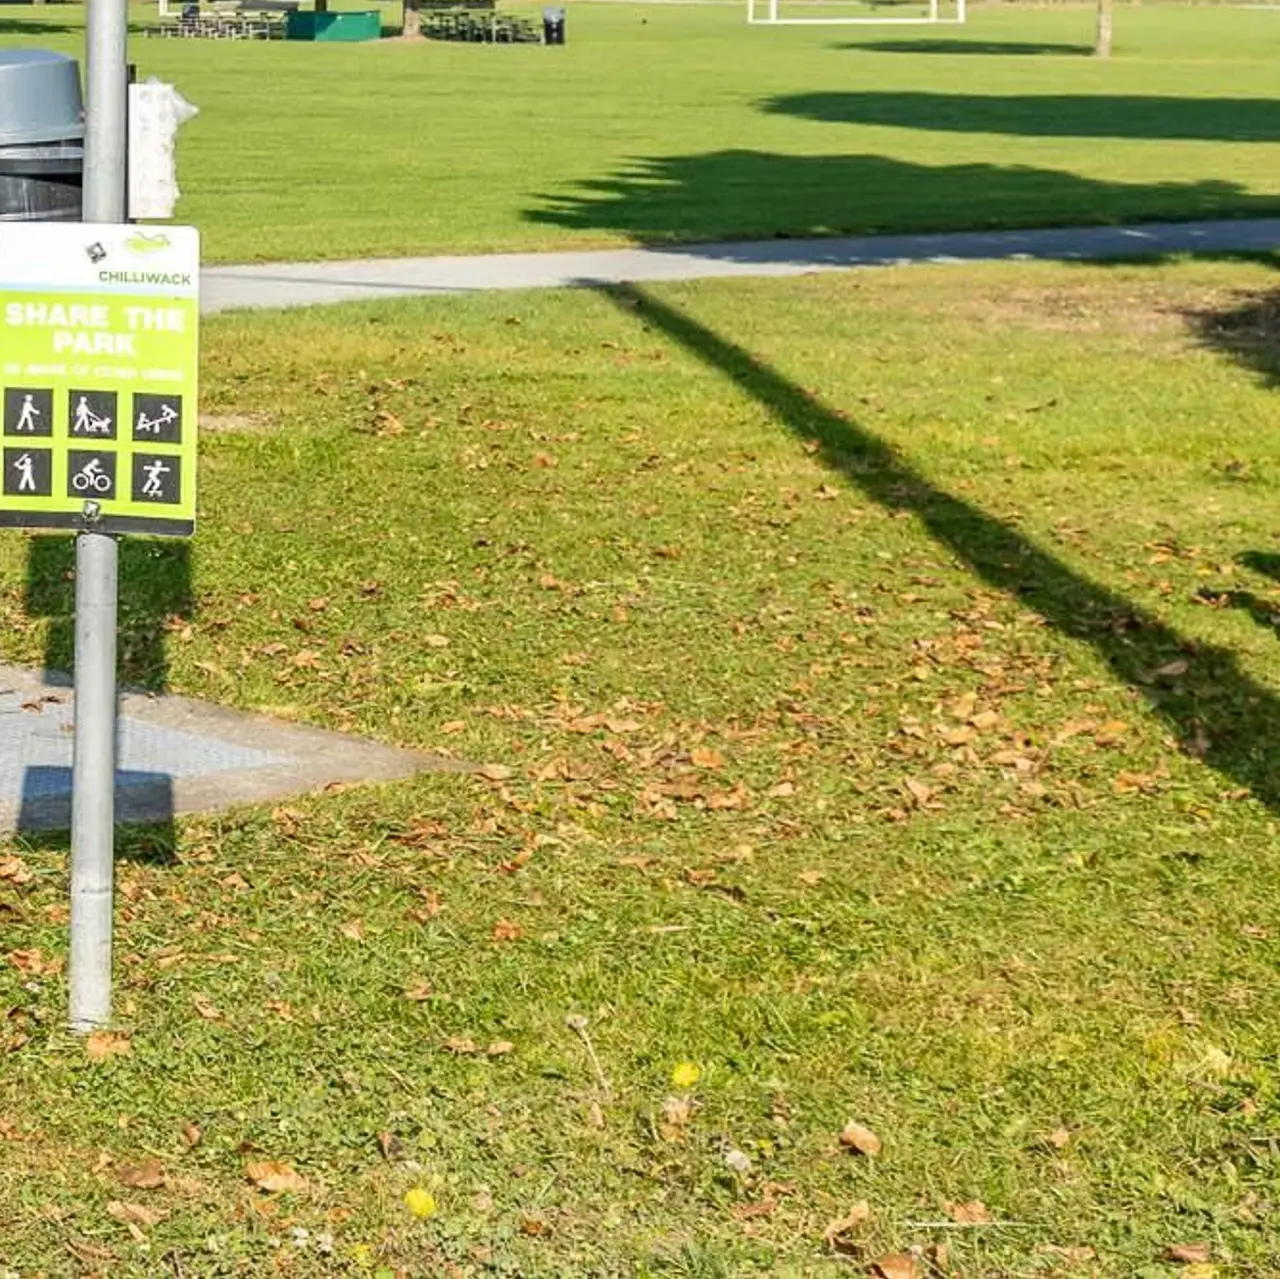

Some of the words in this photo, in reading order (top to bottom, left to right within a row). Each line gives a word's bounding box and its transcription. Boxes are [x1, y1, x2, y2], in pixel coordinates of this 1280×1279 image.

[98, 270, 191, 286] CHILLIWACK
[4, 301, 110, 328] SHARE
[123, 305, 187, 333] THE
[52, 329, 136, 356] PARK
